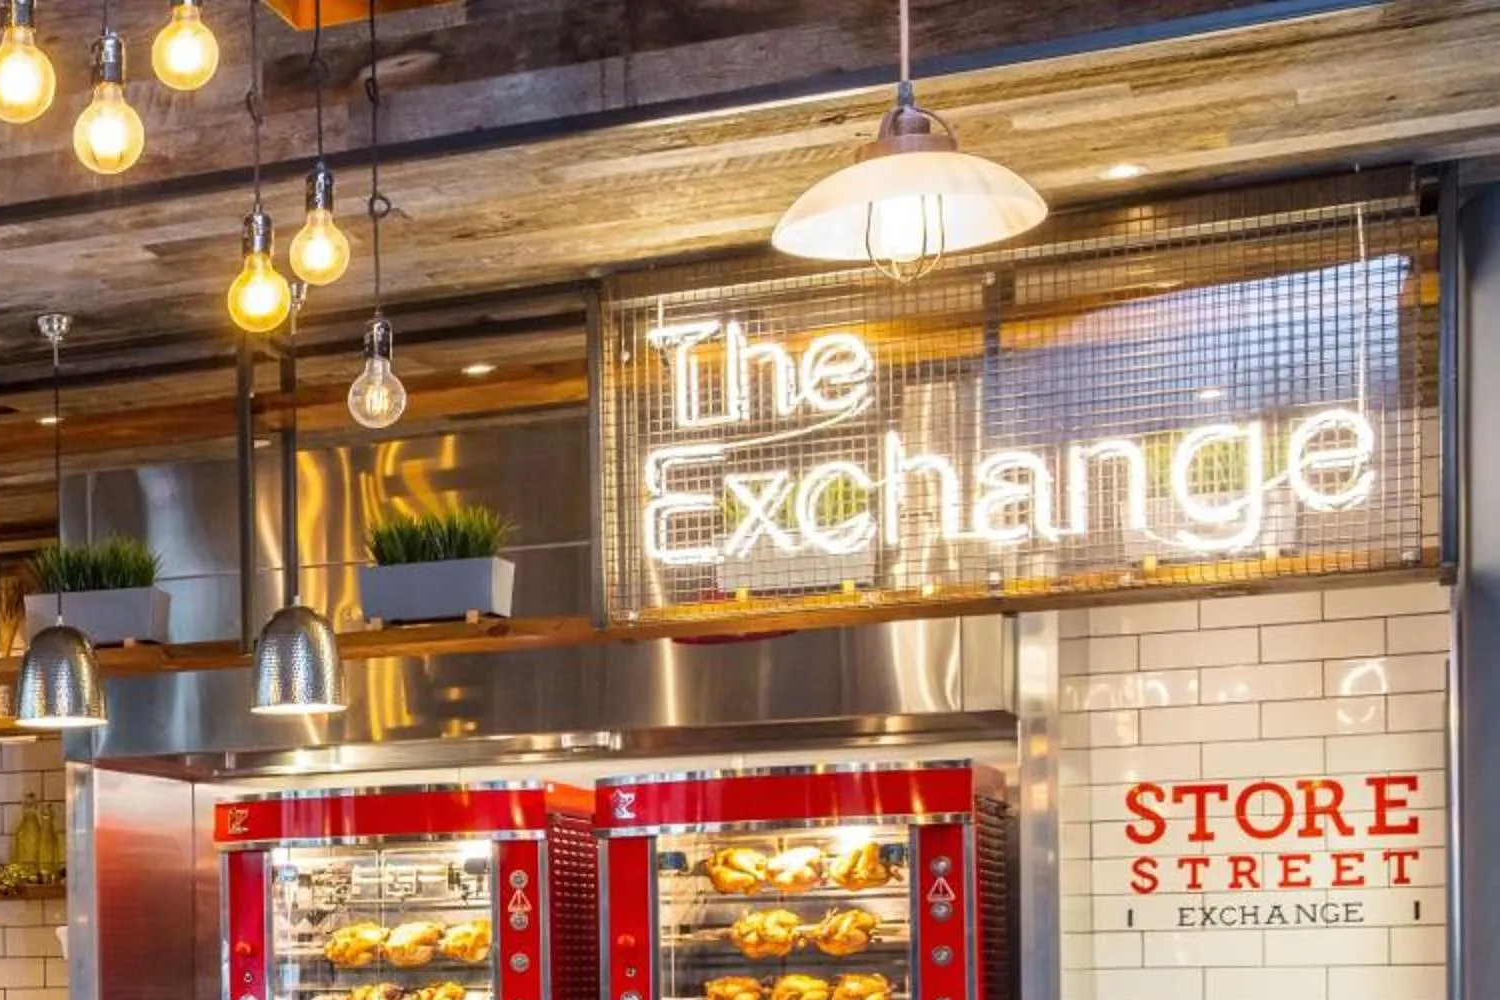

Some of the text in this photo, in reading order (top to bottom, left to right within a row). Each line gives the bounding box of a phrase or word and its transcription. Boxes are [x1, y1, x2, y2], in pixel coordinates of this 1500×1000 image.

[646, 319, 876, 428] The
[643, 407, 1376, 563] Exchange
[1125, 776, 1419, 844] STORE
[1130, 850, 1419, 894] STREET
[1177, 902, 1365, 927] EXCHANGE
